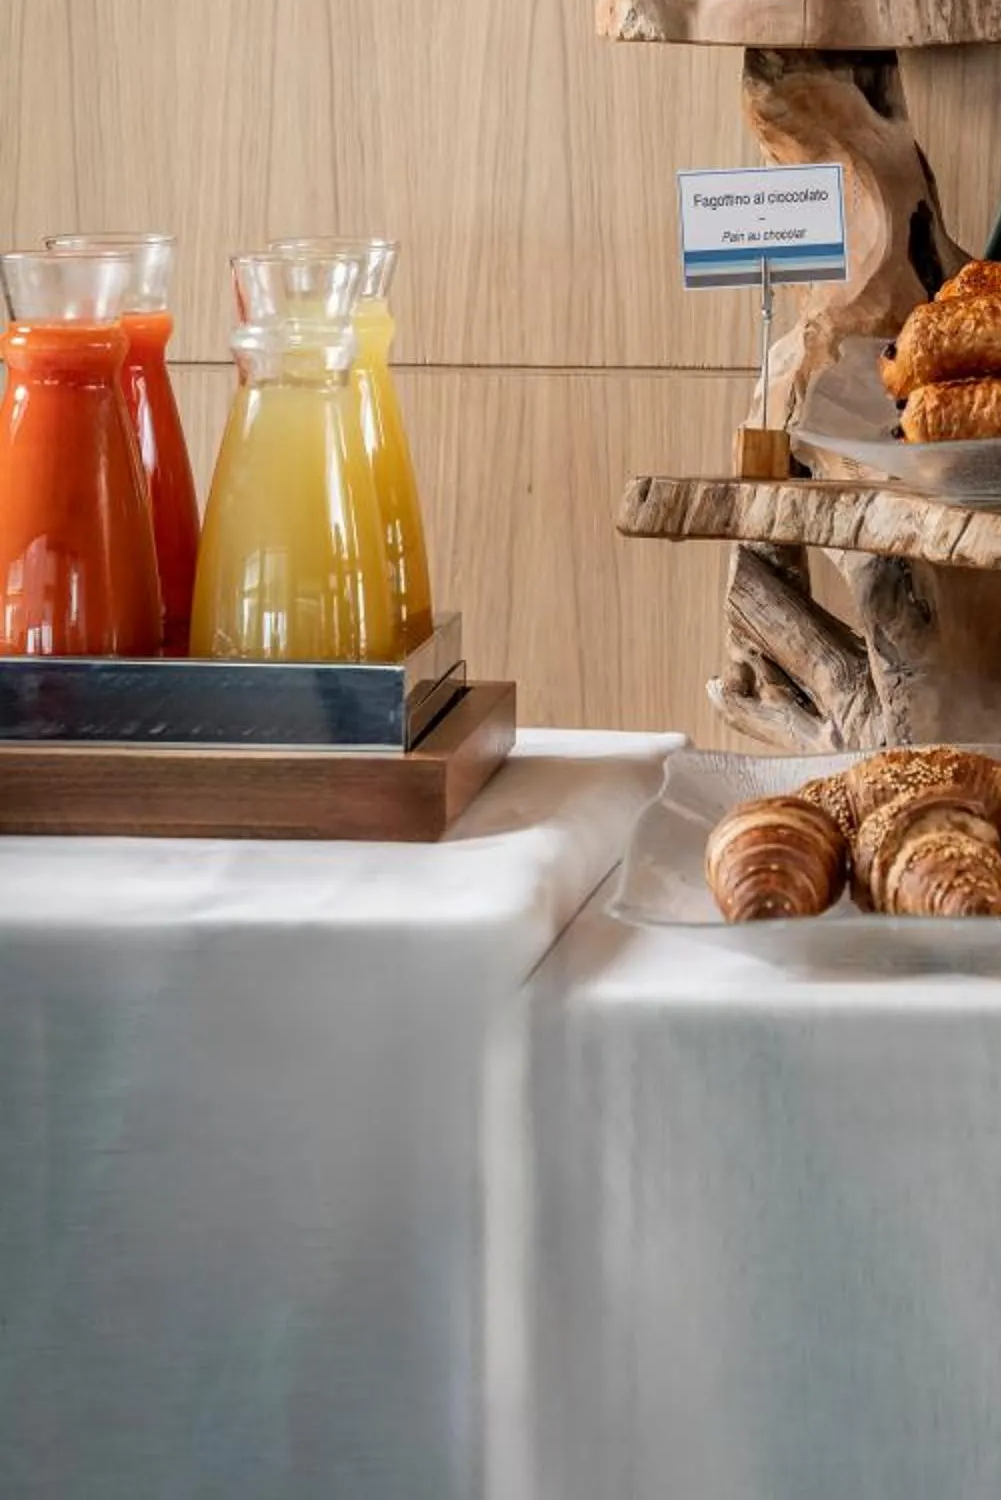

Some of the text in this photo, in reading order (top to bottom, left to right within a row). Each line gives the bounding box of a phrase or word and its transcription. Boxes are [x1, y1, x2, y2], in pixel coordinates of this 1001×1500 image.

[693, 188, 829, 210] Fagottino al cioccolato
